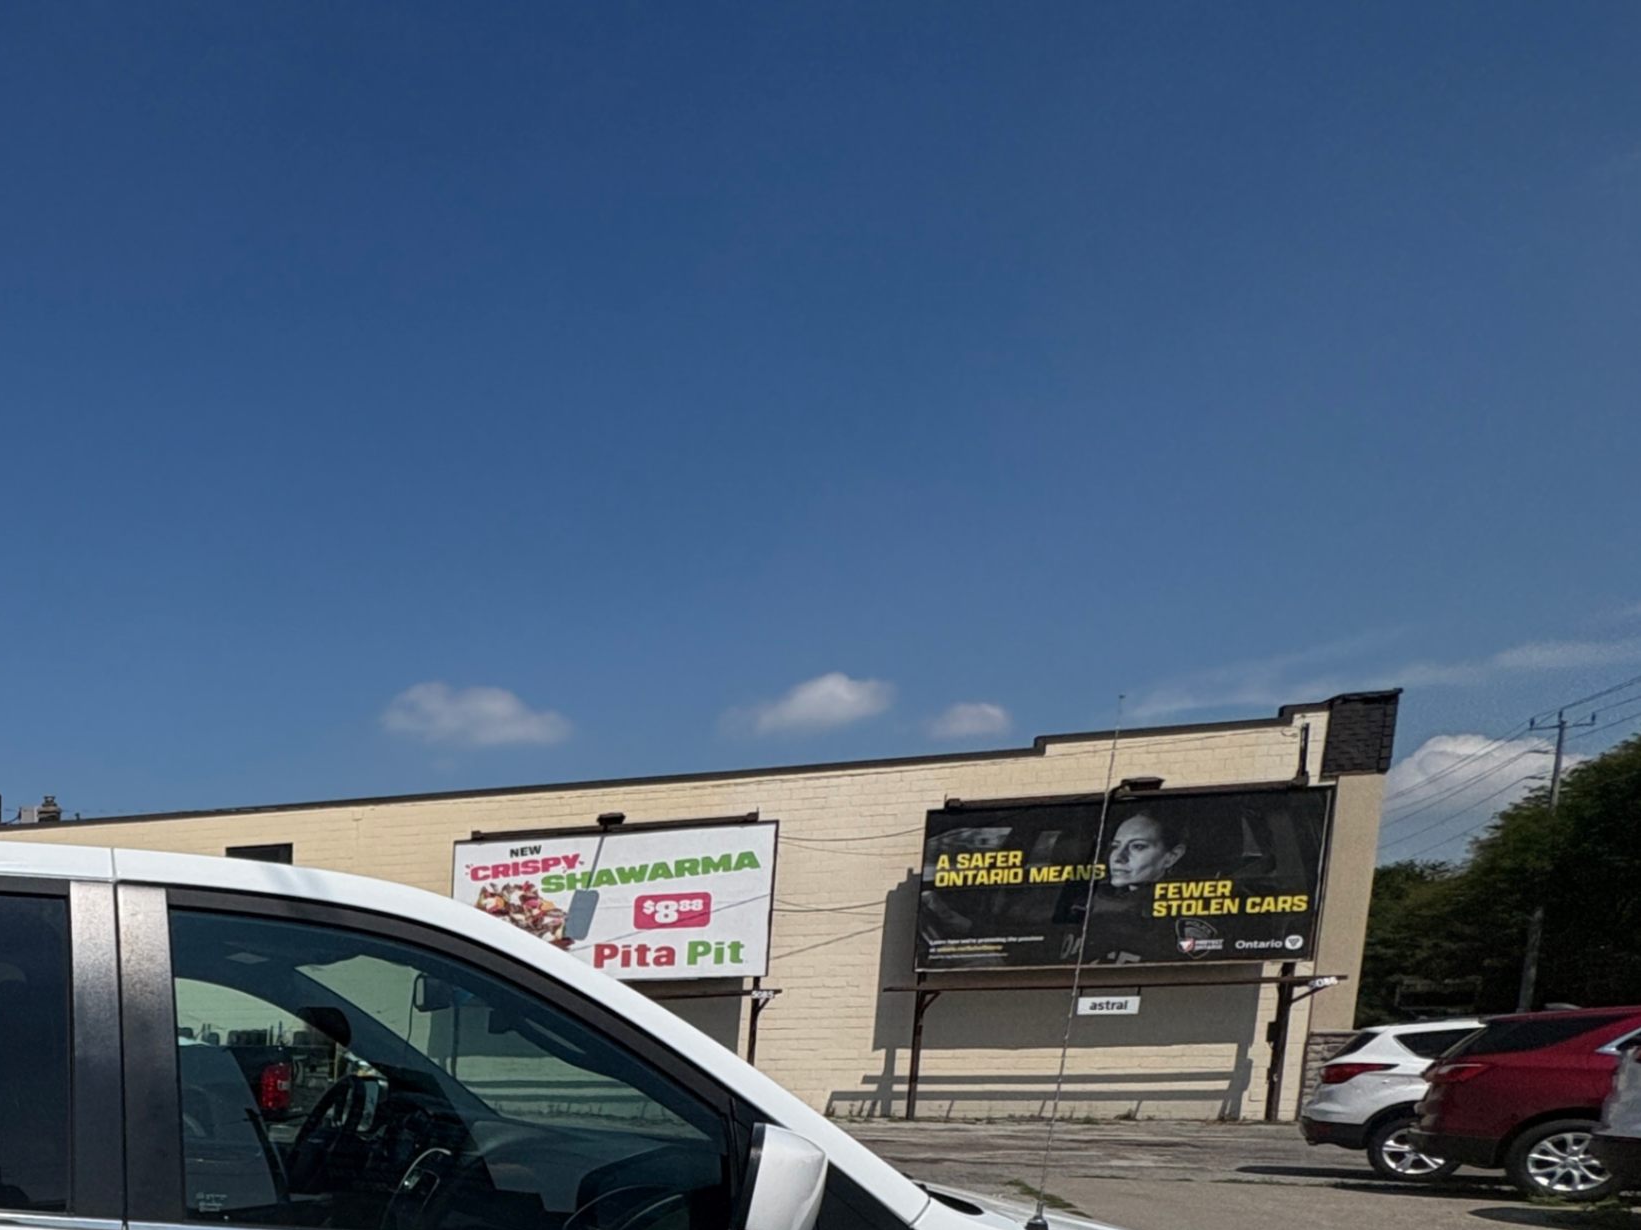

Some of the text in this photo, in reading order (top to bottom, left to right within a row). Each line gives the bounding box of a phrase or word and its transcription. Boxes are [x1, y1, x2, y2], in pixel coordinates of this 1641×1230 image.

[509, 845, 542, 858] NEW
[936, 850, 1023, 870] A SAFER
[470, 853, 581, 882] CRISPY
[541, 851, 761, 893] SHAWARMA
[934, 864, 1106, 888] ONTARIO MEANS
[1154, 880, 1232, 899] FEWER
[1152, 895, 1308, 917] STOLEN CARS
[593, 940, 745, 969] Pita Pit
[1235, 939, 1283, 950] Ontario
[1089, 999, 1128, 1011] astral
